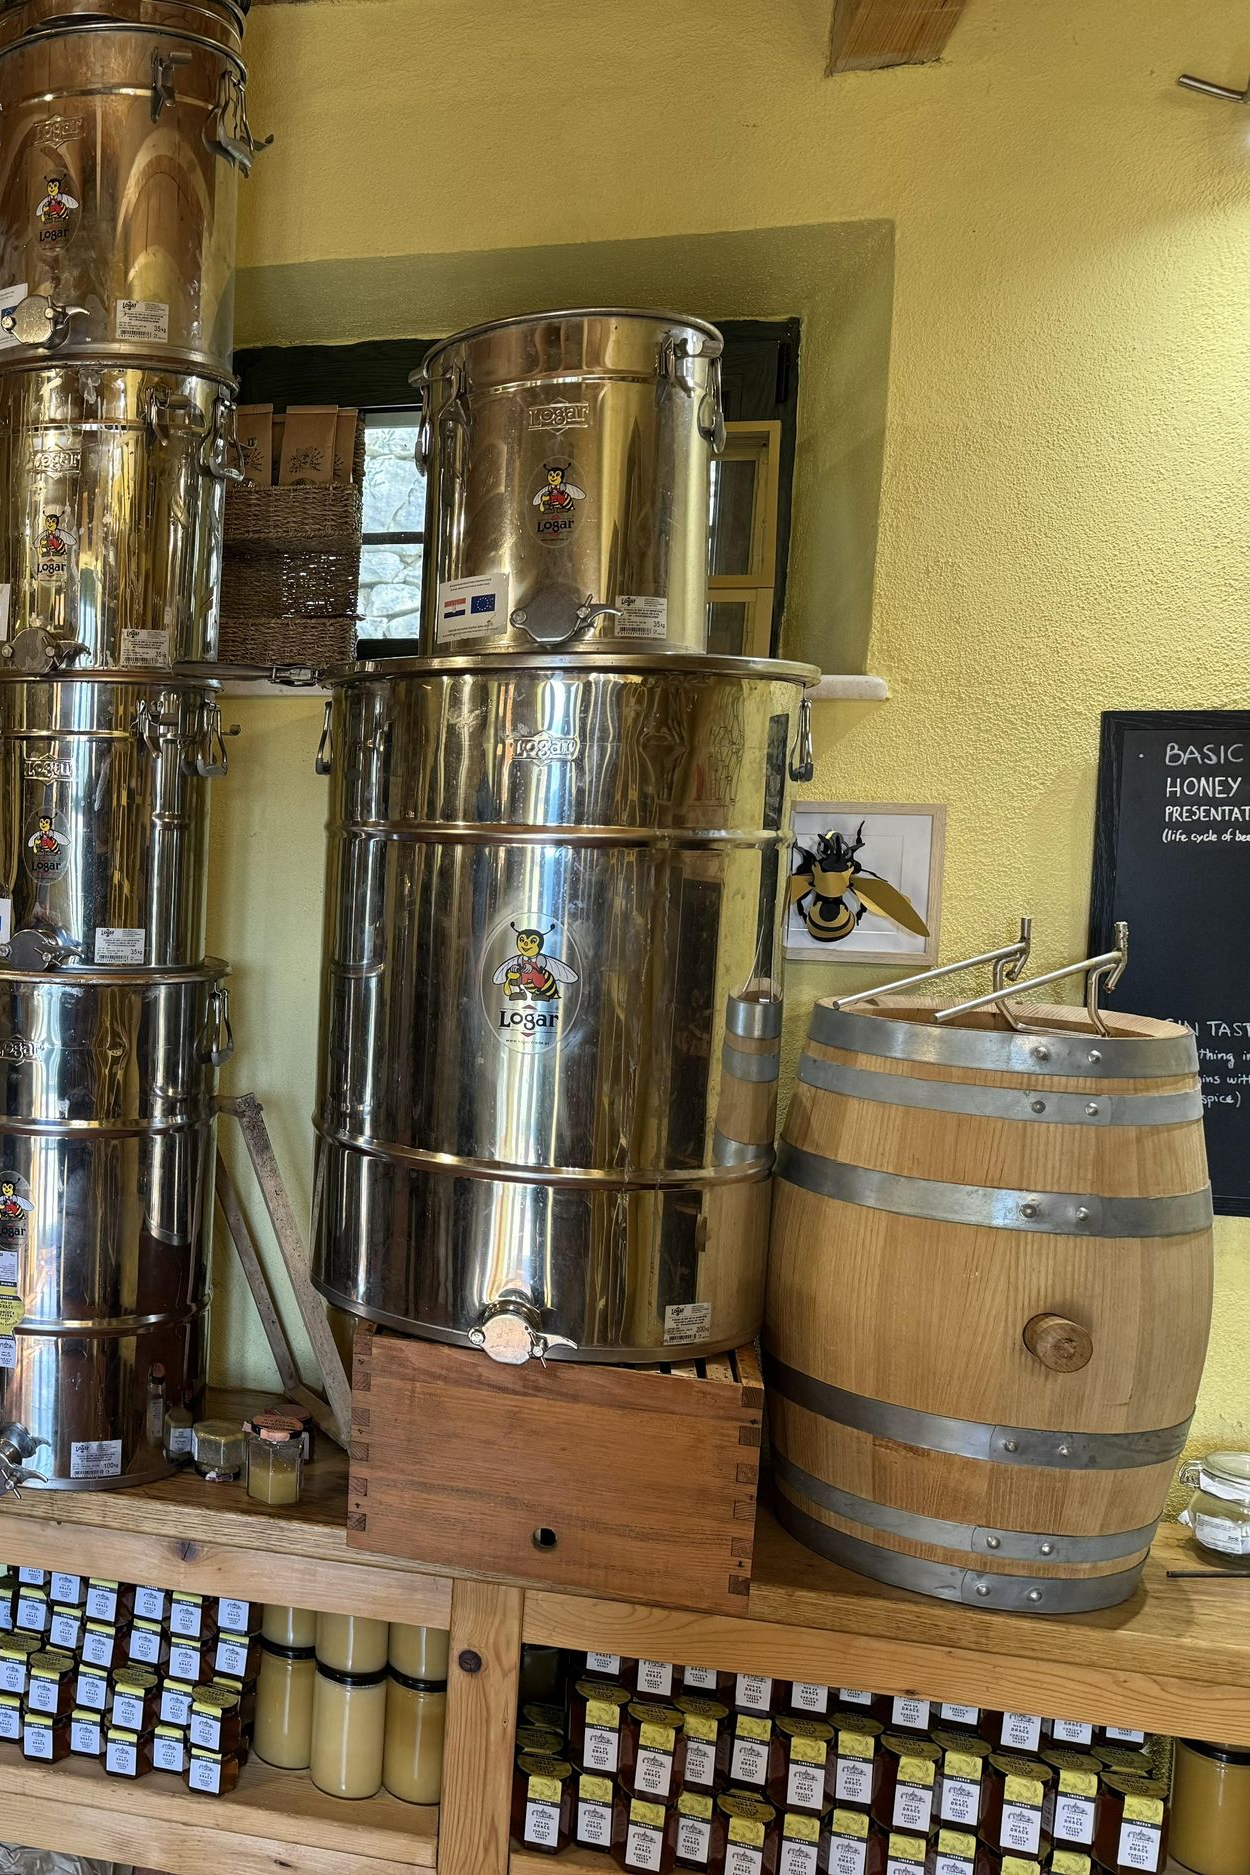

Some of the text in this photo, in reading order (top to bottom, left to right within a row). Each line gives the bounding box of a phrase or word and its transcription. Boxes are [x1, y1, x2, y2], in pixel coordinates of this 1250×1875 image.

[39, 228, 70, 242] Logar
[530, 405, 589, 428] Logar
[537, 519, 575, 533] Logar
[37, 562, 67, 575] Logar
[515, 738, 576, 757] Logar
[1165, 742, 1244, 766] BASIC
[1166, 776, 1242, 798] HONEY
[1162, 828, 1188, 843] (life
[1190, 829, 1218, 843] cycle
[1221, 828, 1233, 842] of
[31, 861, 61, 873] Logar
[499, 1011, 559, 1031] Logar
